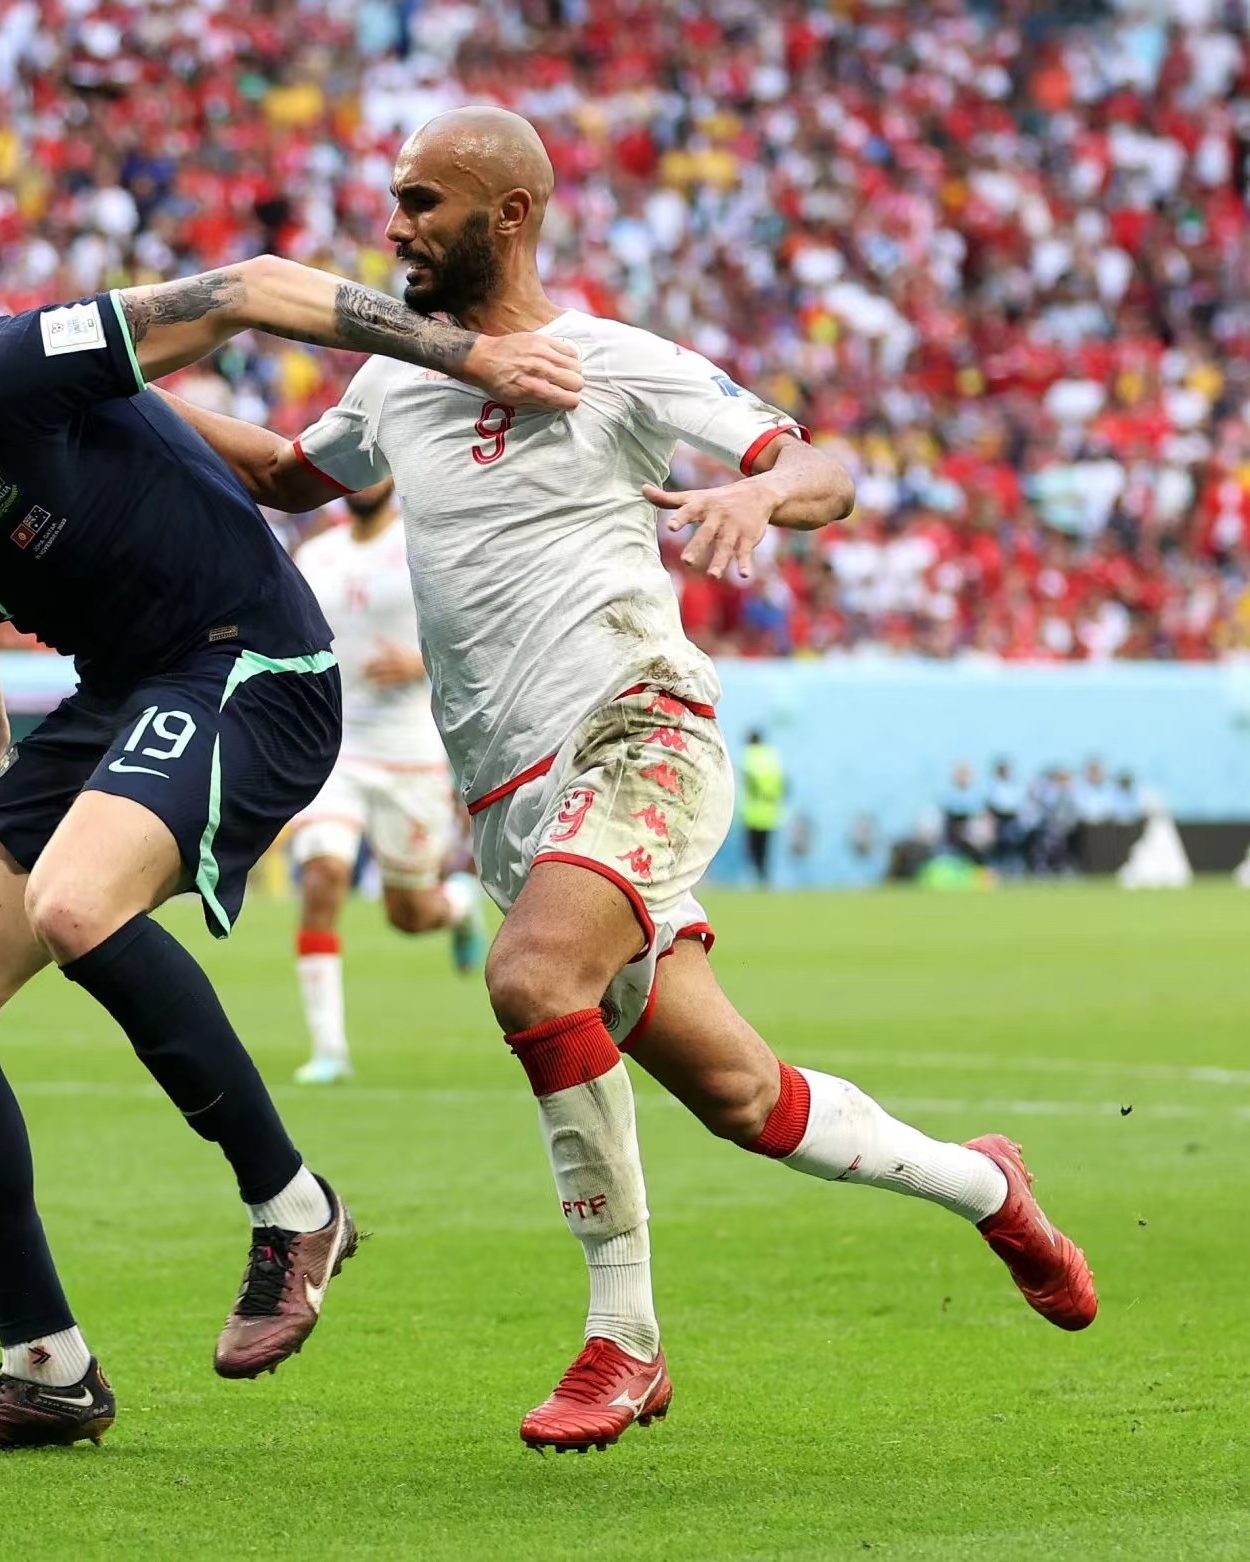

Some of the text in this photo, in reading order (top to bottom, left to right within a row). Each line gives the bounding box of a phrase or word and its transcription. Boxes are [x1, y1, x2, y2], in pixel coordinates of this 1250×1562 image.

[471, 400, 516, 465] 9
[123, 705, 197, 760] 19
[549, 790, 595, 842] 9
[561, 1193, 607, 1219] FTF
